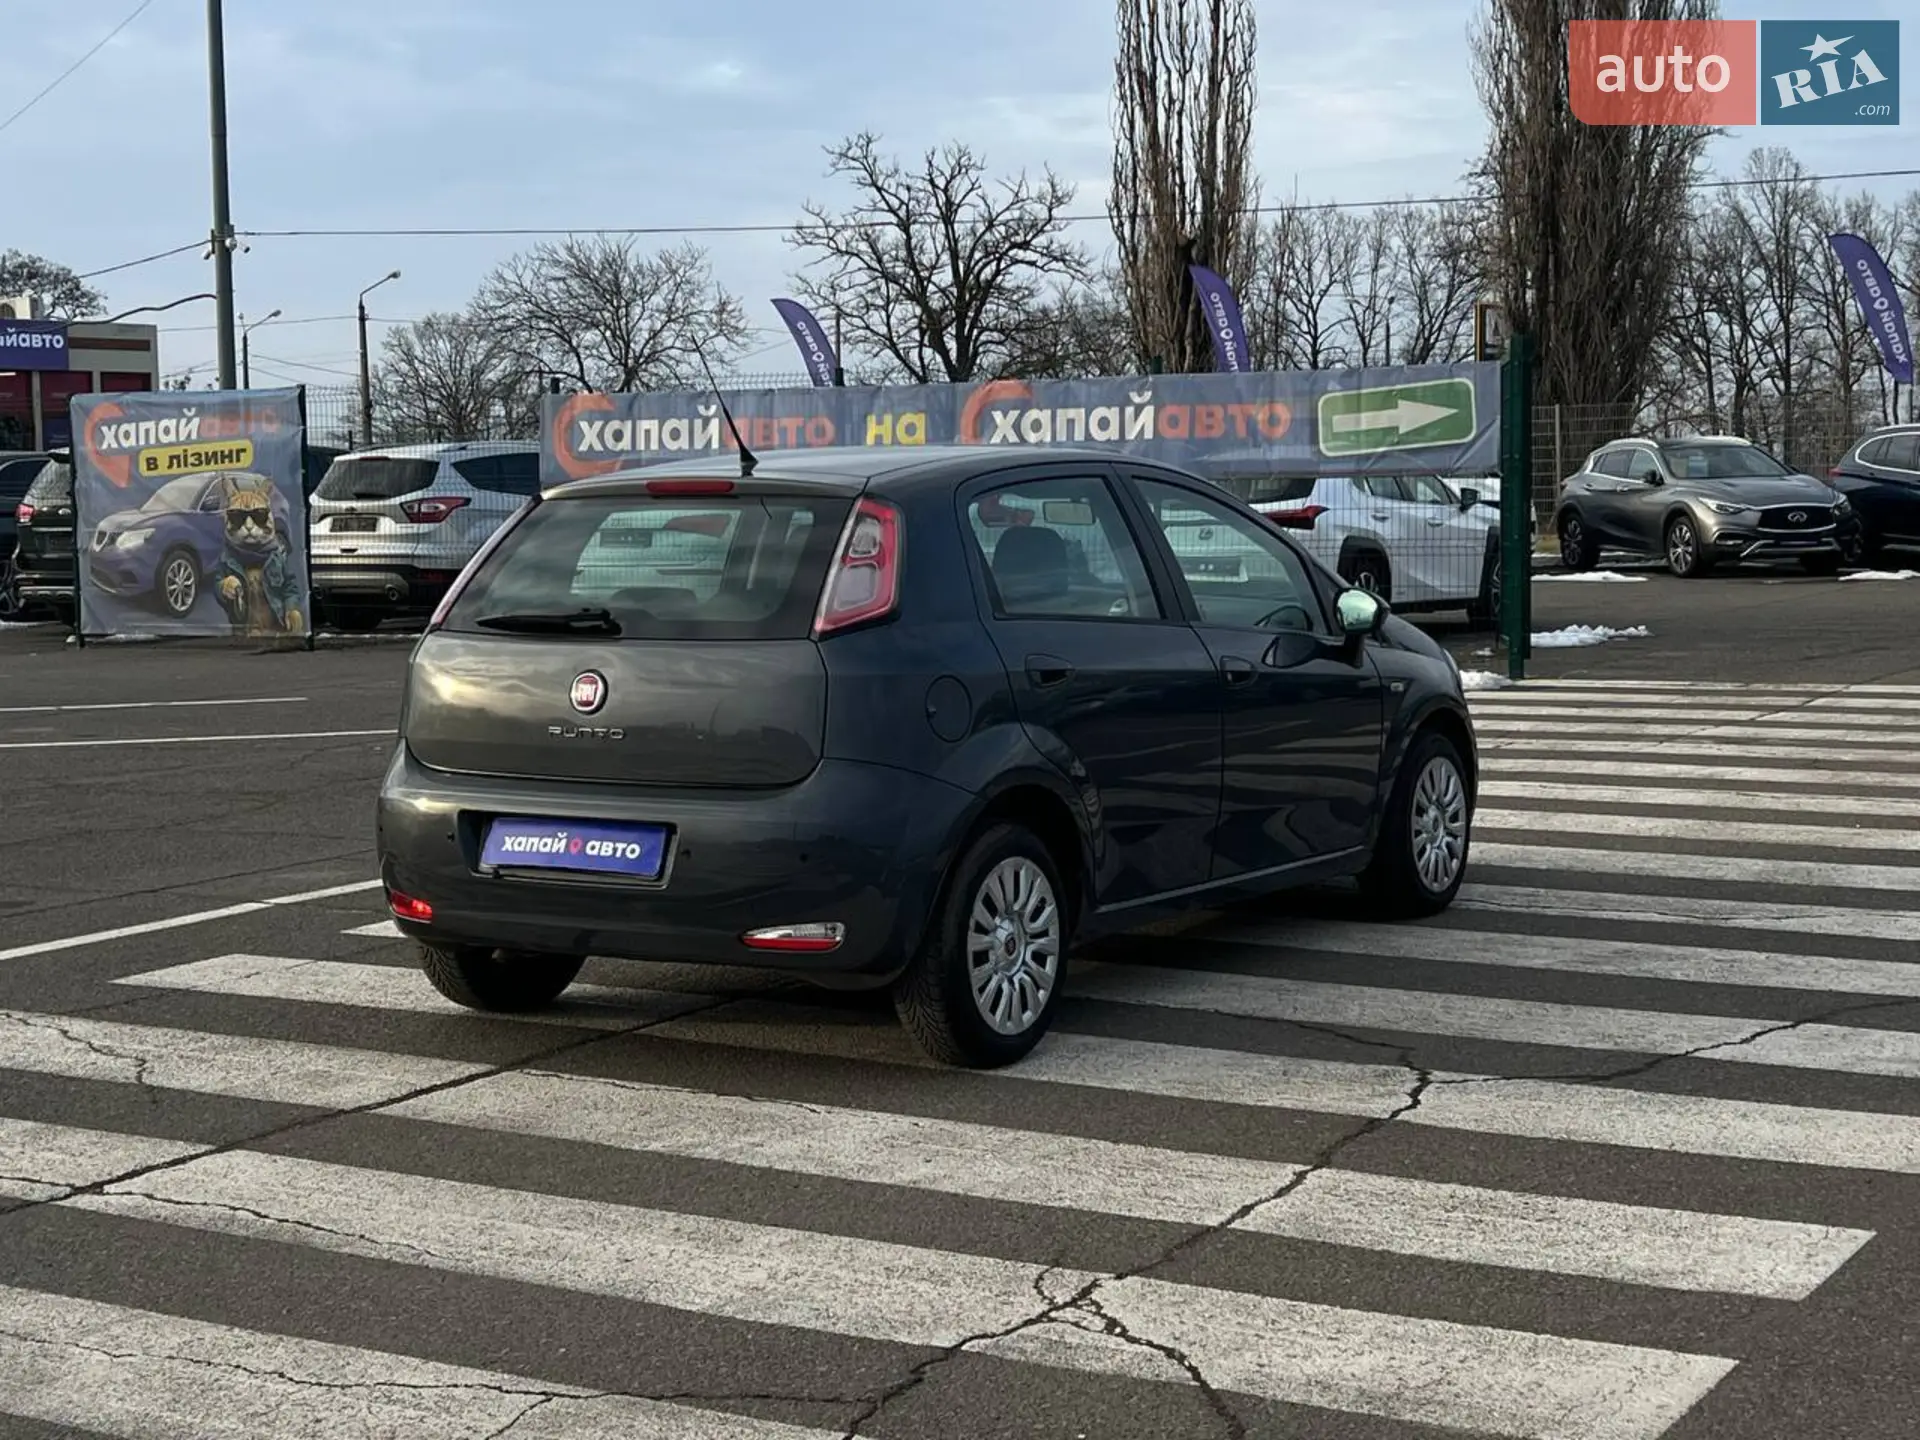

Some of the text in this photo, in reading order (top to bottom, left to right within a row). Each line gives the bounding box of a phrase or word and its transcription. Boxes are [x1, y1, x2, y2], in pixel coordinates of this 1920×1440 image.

[866, 412, 927, 446] на
[145, 447, 247, 471] в лізинг
